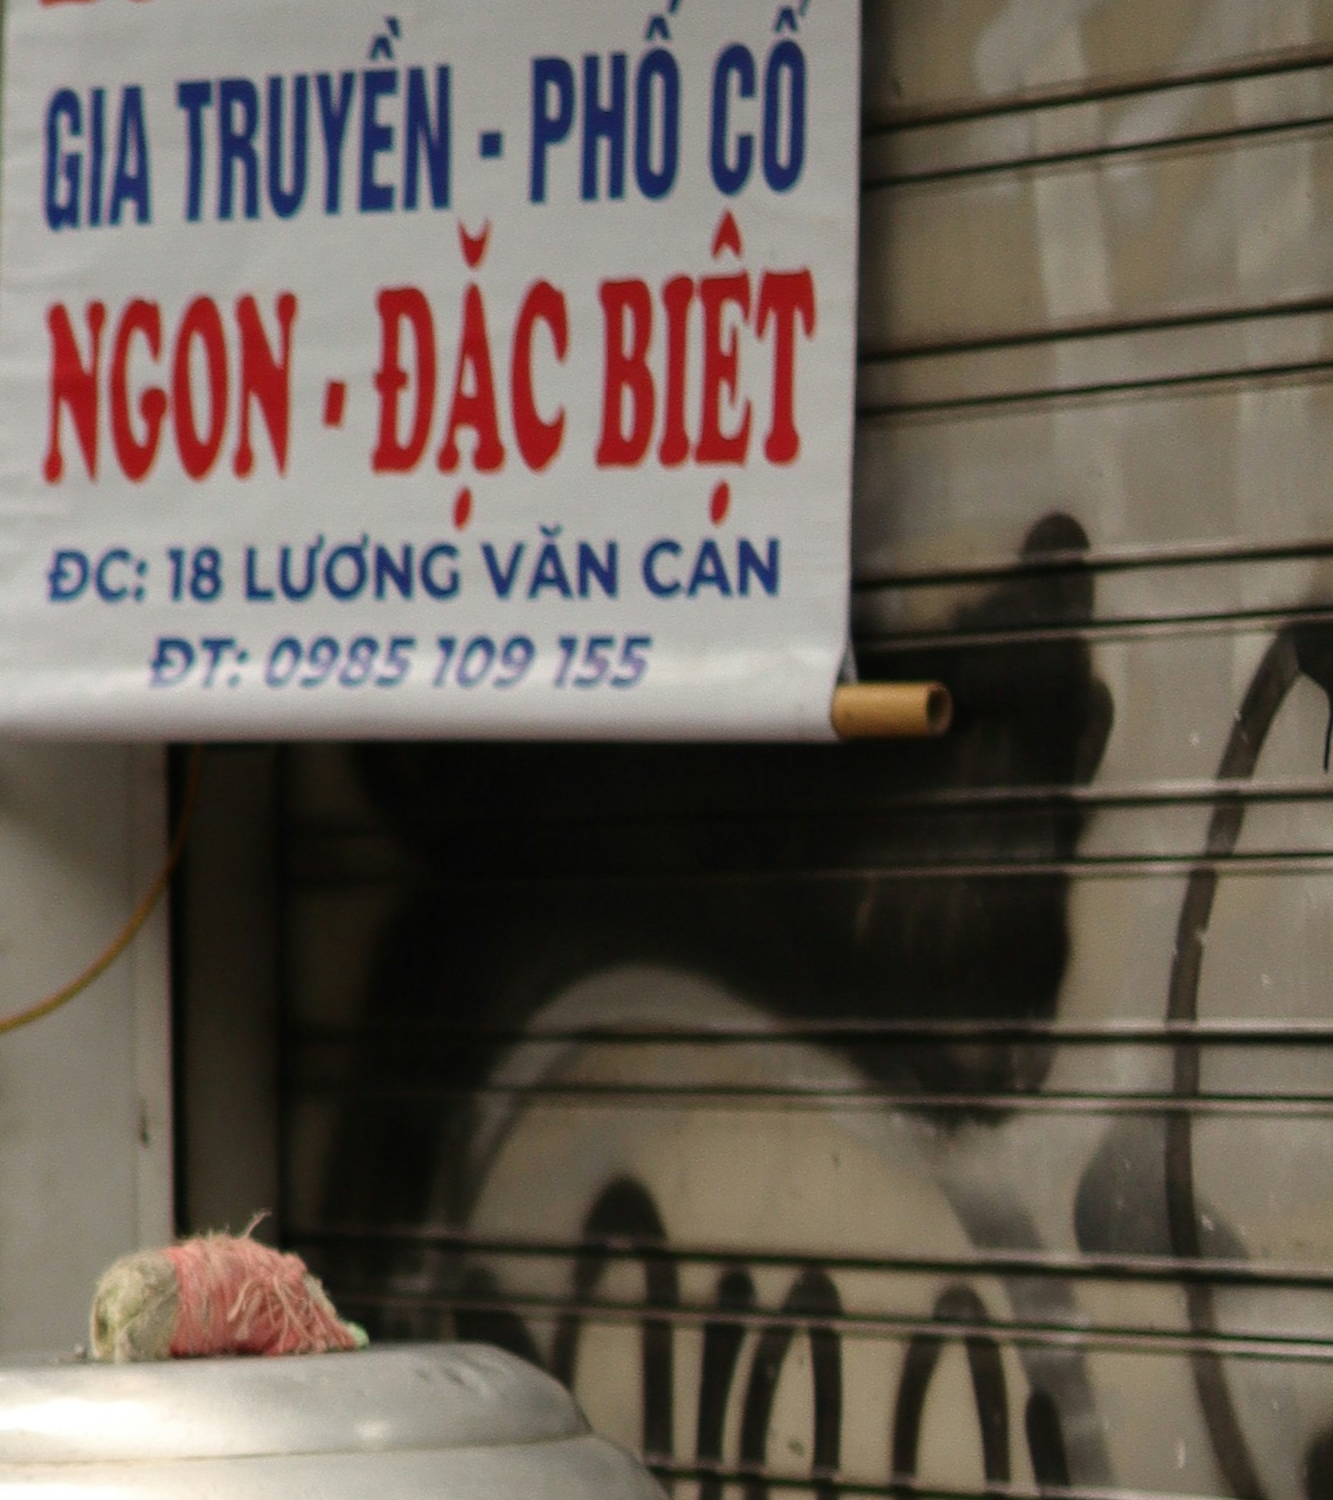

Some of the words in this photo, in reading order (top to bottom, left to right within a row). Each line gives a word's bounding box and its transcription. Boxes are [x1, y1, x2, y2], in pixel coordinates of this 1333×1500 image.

[44, 85, 151, 232] GIA
[178, 17, 452, 222] TRUYỀN
[44, 292, 297, 484] NGON
[371, 216, 569, 530] ĐẶC
[594, 209, 815, 526] BIỆT
[48, 550, 146, 603] ĐC:
[168, 544, 223, 601] 18
[242, 534, 460, 600] LƯƠNG
[482, 524, 619, 599] VĂN
[641, 537, 781, 597] CAN
[148, 637, 249, 691] ĐT:
[263, 636, 410, 689] 0985
[433, 636, 538, 689] 109
[553, 635, 652, 688] 155
